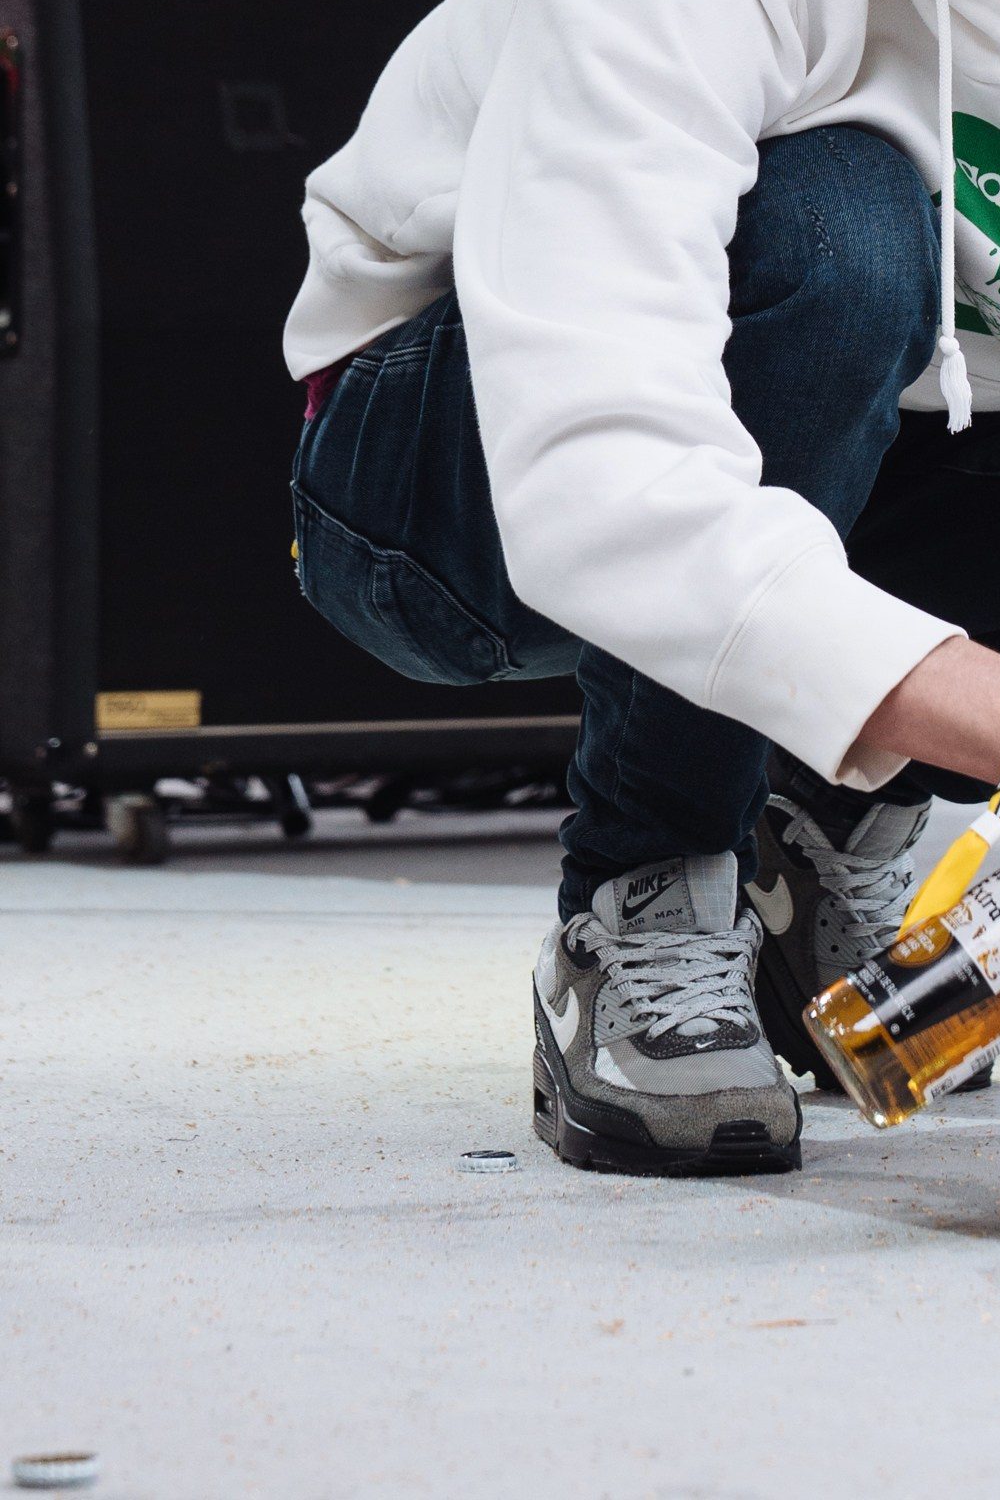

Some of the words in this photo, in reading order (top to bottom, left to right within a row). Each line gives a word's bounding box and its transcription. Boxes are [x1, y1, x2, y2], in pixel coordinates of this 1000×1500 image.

[626, 871, 669, 901] NIKE
[626, 917, 646, 931] AIR
[654, 907, 684, 920] MAX
